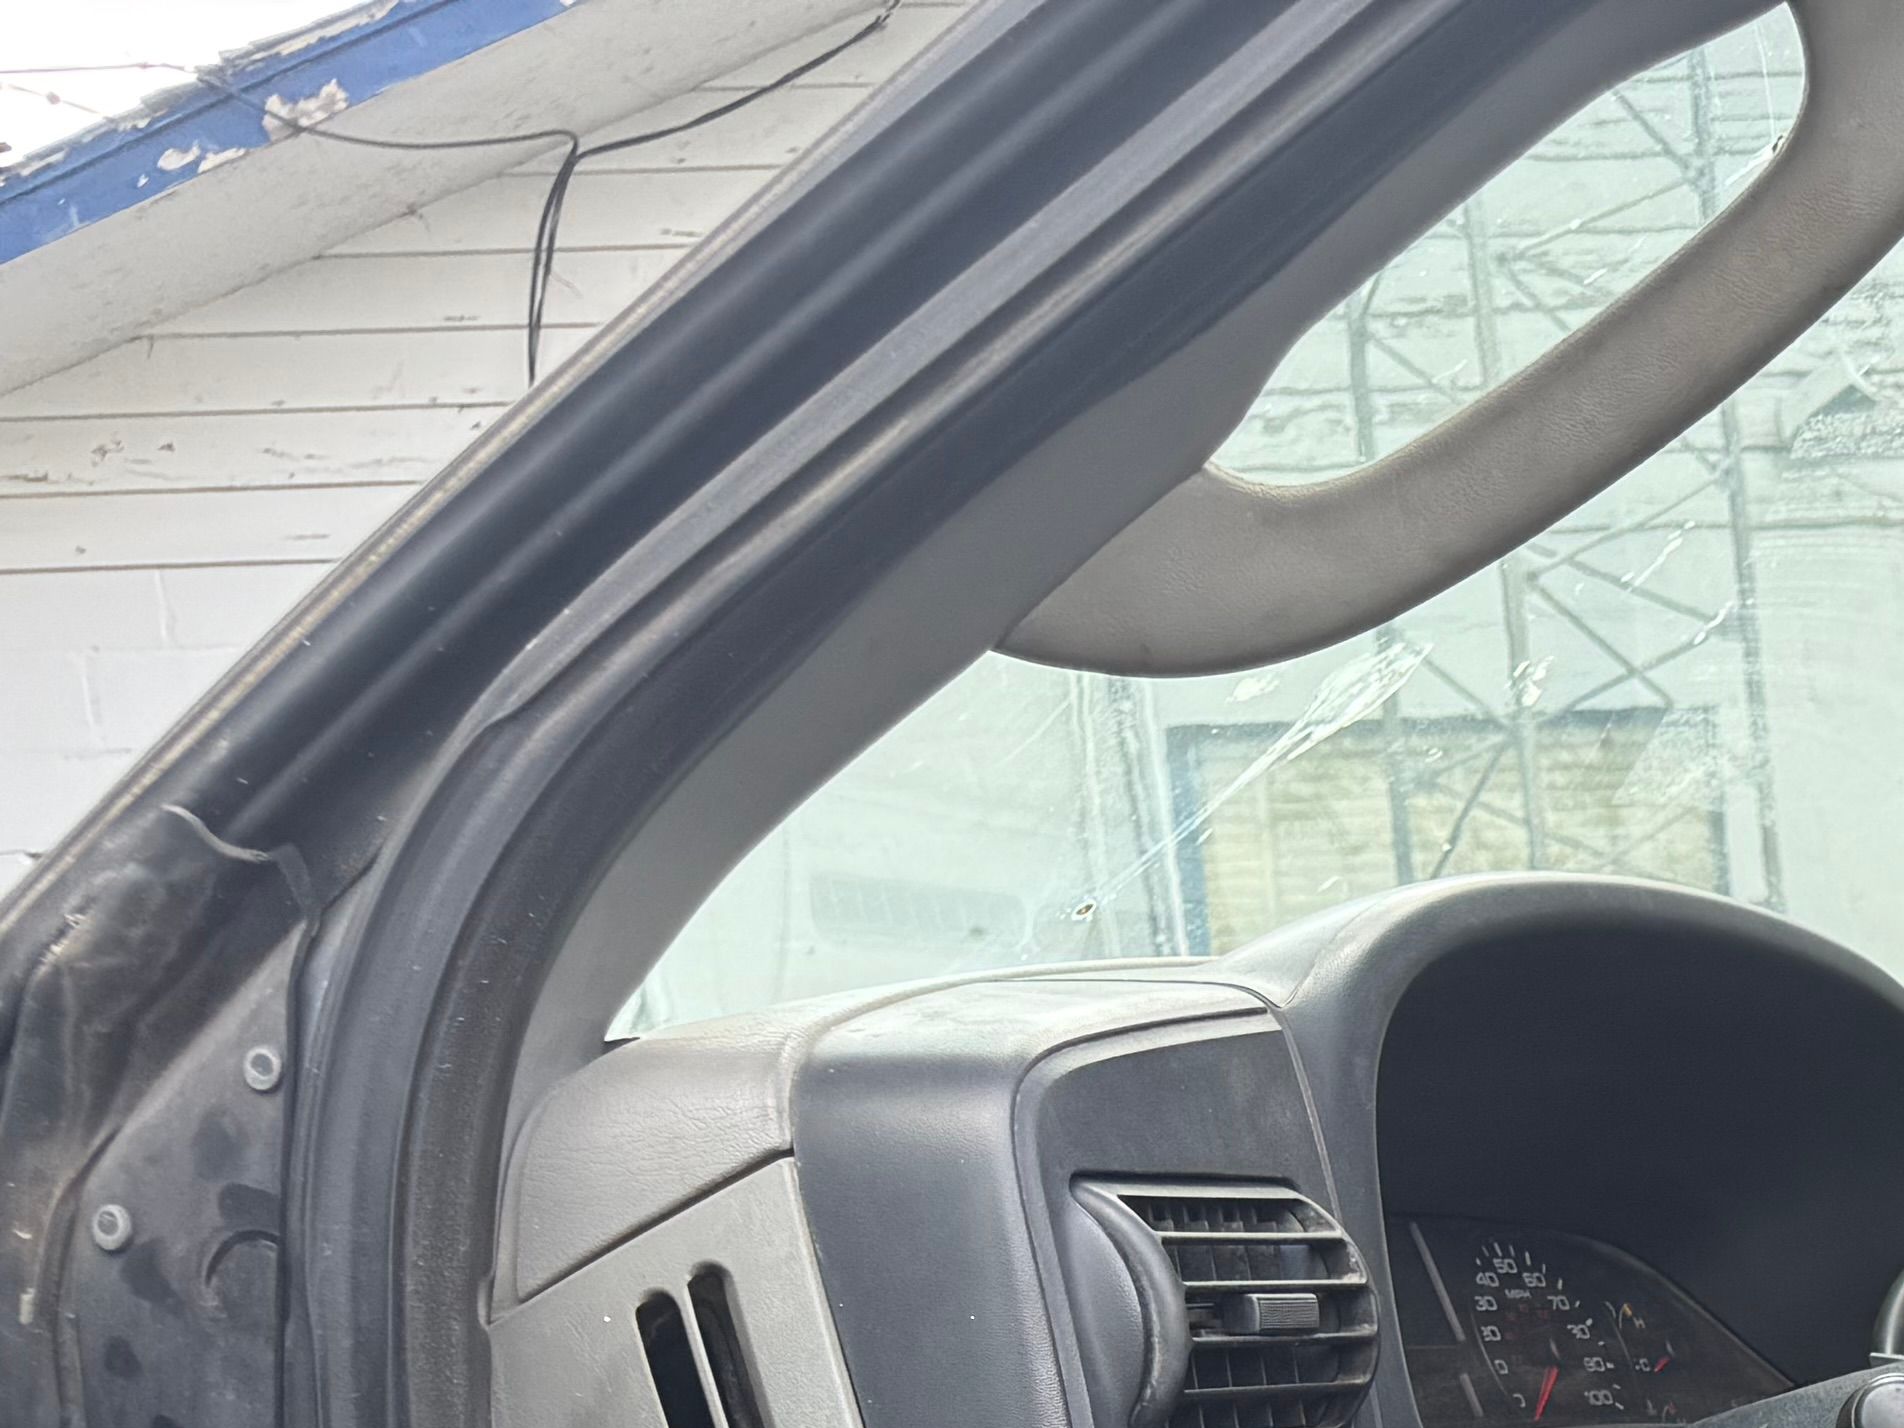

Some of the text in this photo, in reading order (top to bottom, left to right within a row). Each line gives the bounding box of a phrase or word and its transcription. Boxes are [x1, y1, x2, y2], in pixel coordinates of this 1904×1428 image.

[1493, 1258, 1517, 1273] 50
[1476, 1272, 1499, 1287] 40
[1522, 1272, 1546, 1287] 60
[1474, 1296, 1498, 1311] 30
[1547, 1295, 1570, 1311] 70
